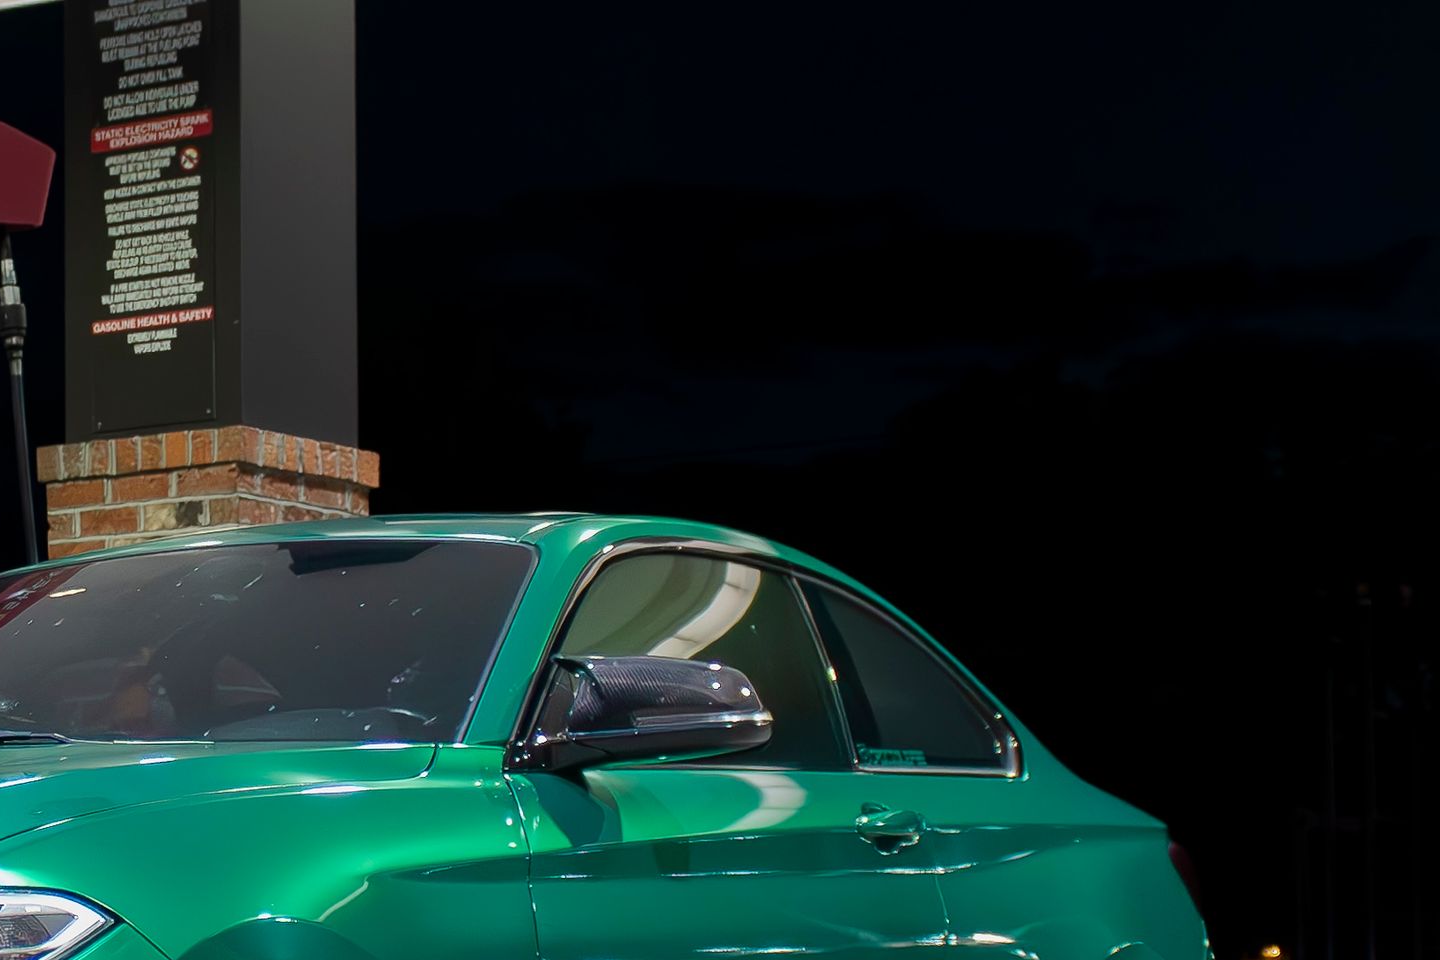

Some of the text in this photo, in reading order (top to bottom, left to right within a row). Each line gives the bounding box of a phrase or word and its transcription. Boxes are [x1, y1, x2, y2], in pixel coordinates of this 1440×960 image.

[95, 113, 209, 142] STATIC ELECTRICITY SPARK
[109, 127, 194, 149] EXPLOSION HAZARD
[92, 308, 213, 334] GASOLINE HEALTH & SAFETY
